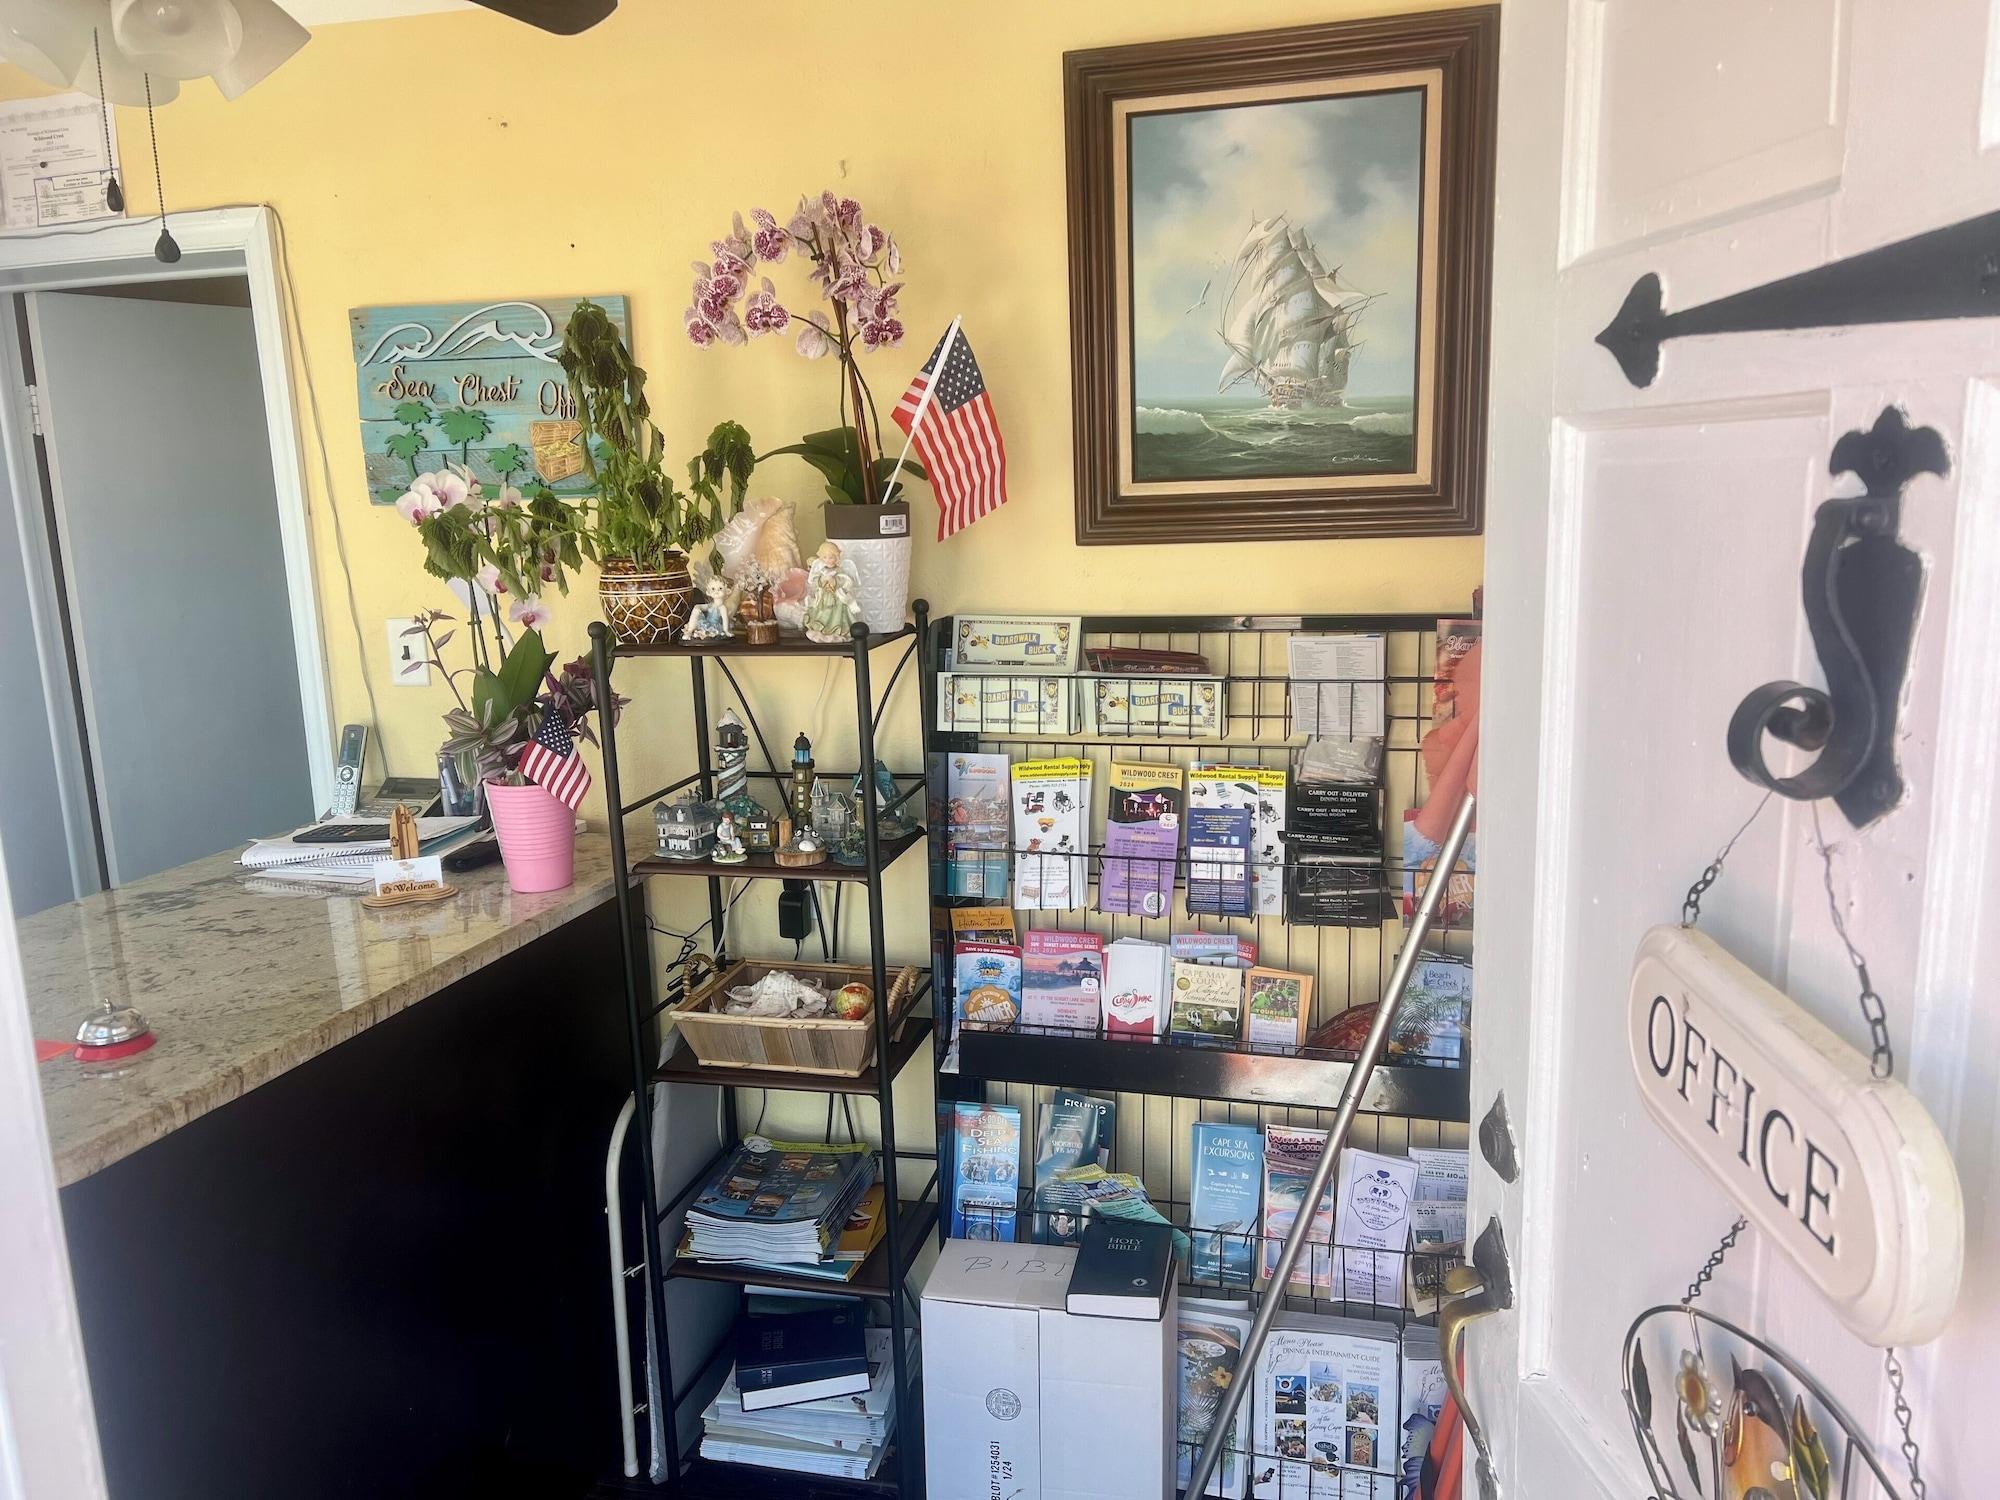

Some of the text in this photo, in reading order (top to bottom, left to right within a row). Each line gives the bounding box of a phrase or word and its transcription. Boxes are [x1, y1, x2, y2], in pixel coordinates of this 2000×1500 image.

[378, 365, 435, 401] Sea
[453, 374, 522, 408] Chest
[995, 633, 1037, 646] BOARDWALK
[1028, 644, 1051, 655] BUCKS
[1172, 705, 1197, 716] BUCS
[1018, 764, 1043, 772] Wildwood
[1062, 763, 1079, 771] Supply
[1121, 769, 1156, 778] WILDWOOD
[1157, 771, 1179, 779] CREST
[393, 882, 436, 893] Welcome
[1044, 935, 1099, 944] WILDWOOD CREST
[1176, 937, 1234, 945] WILDWOOD CREST
[1182, 969, 1226, 979] CAPE MAY
[1191, 977, 1229, 987] COUNTY
[1648, 995, 1840, 1257] OFFICE
[978, 1137, 1002, 1146] SEA
[1212, 1137, 1249, 1150] CAPE SEA
[1271, 1143, 1320, 1151] DOLPHI
[962, 1144, 1017, 1155] FISHING
[1203, 1146, 1255, 1160] EXCURSIONS
[1107, 1243, 1142, 1251] BIBLE
[1311, 1349, 1359, 1360] ENTERTAINMENT
[1003, 1460, 1013, 1480] 1/24
